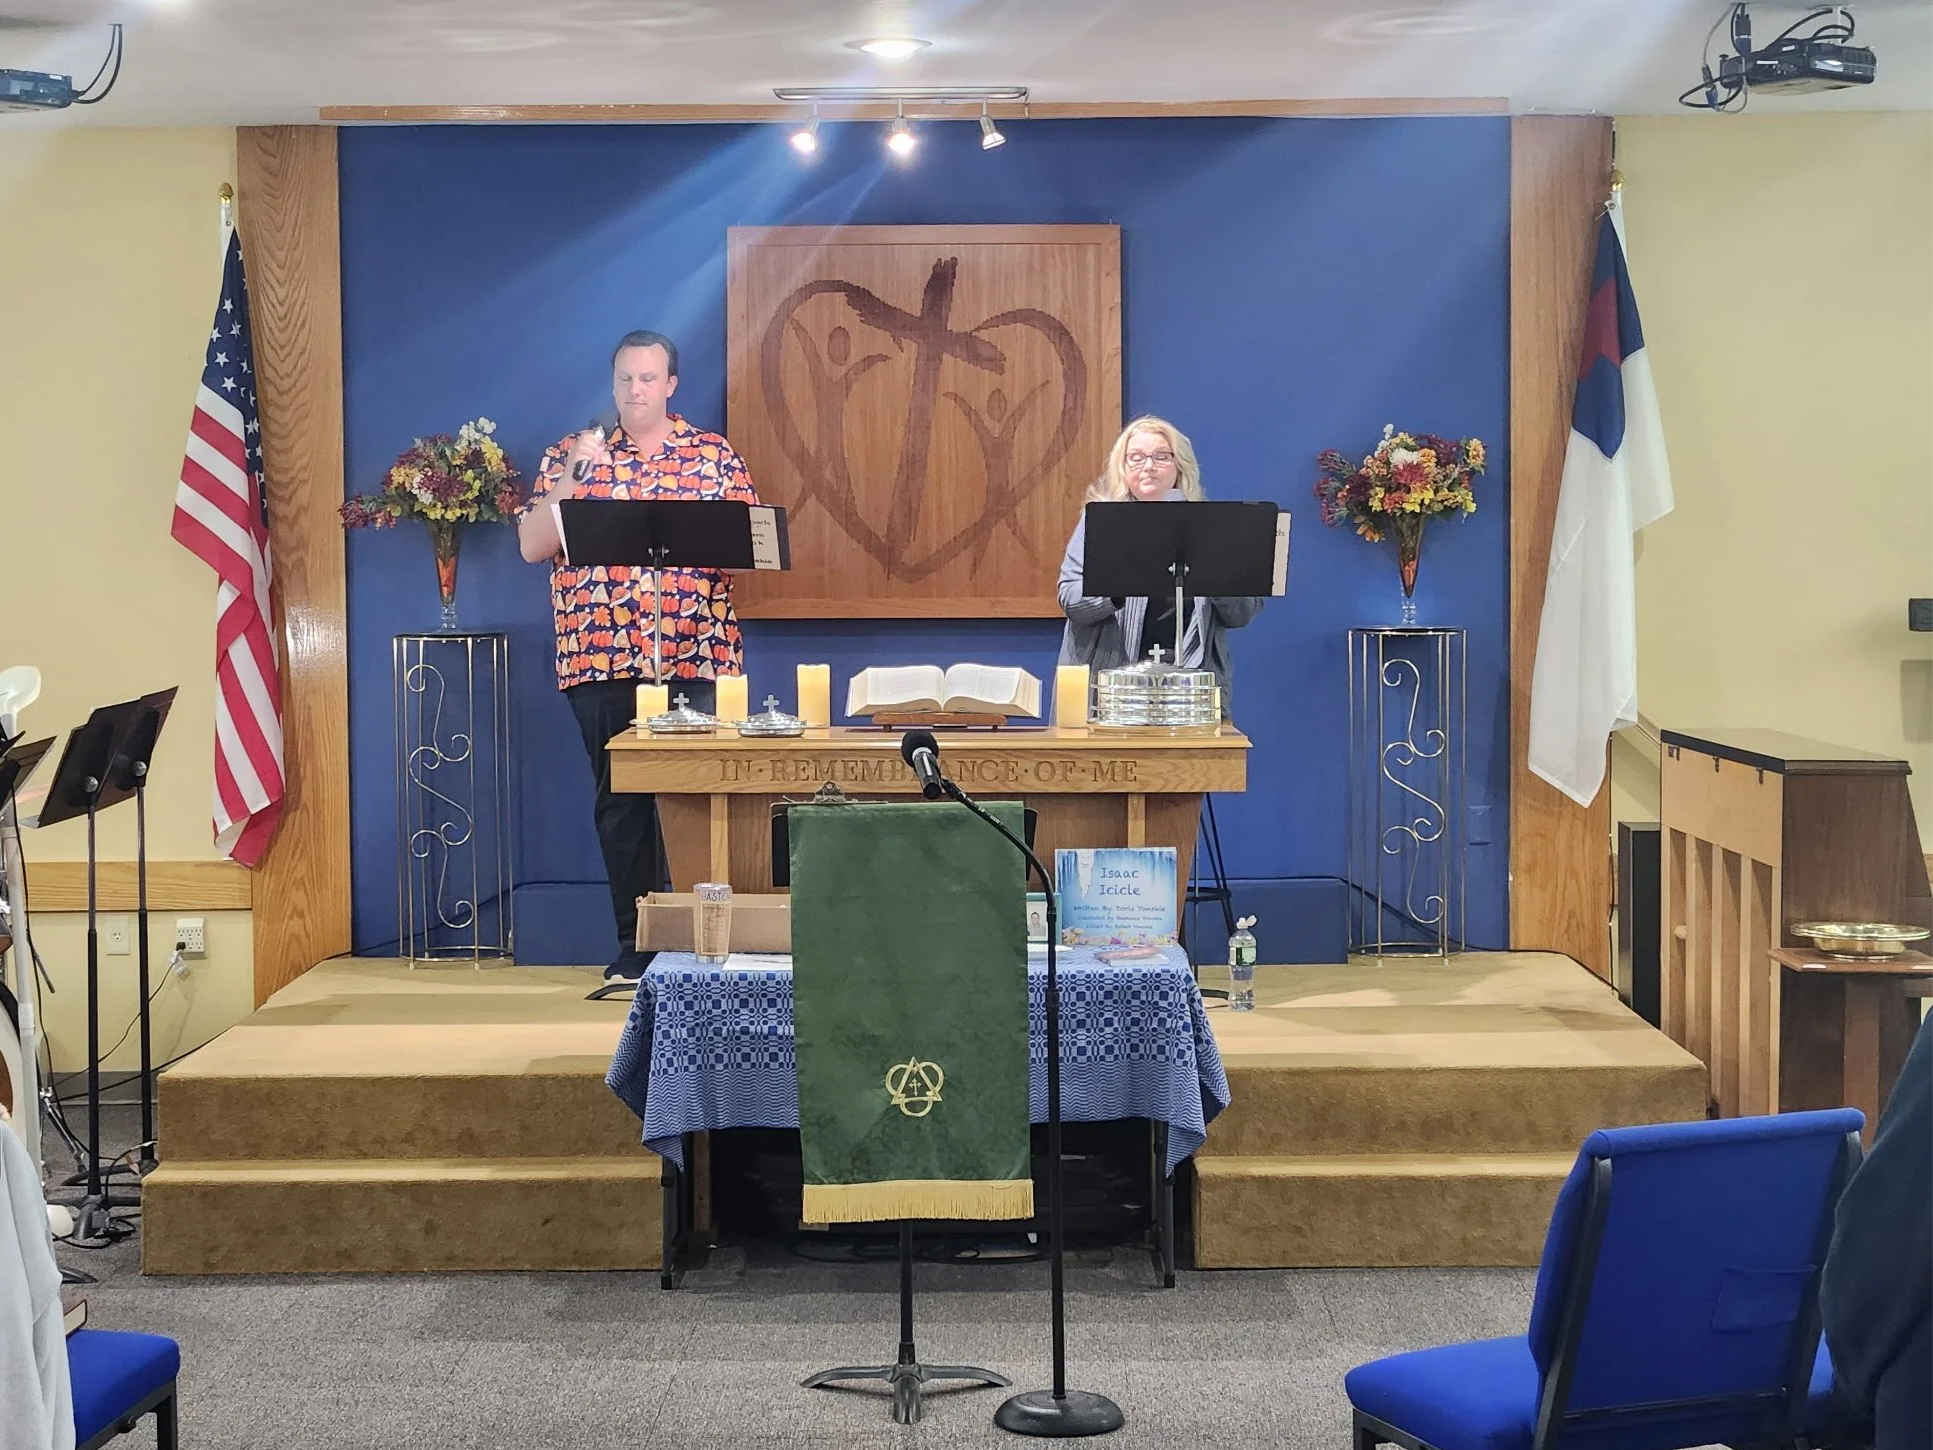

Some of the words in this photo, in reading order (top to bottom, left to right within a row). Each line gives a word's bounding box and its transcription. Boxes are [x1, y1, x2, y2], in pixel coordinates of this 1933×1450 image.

[719, 759, 752, 782] IN
[769, 758, 1020, 783] REMEMBANCE
[1034, 759, 1077, 783] OF
[1091, 759, 1138, 783] ME
[1100, 867, 1140, 879] Isaac
[1098, 884, 1142, 896] Icicle
[1102, 905, 1112, 916] By
